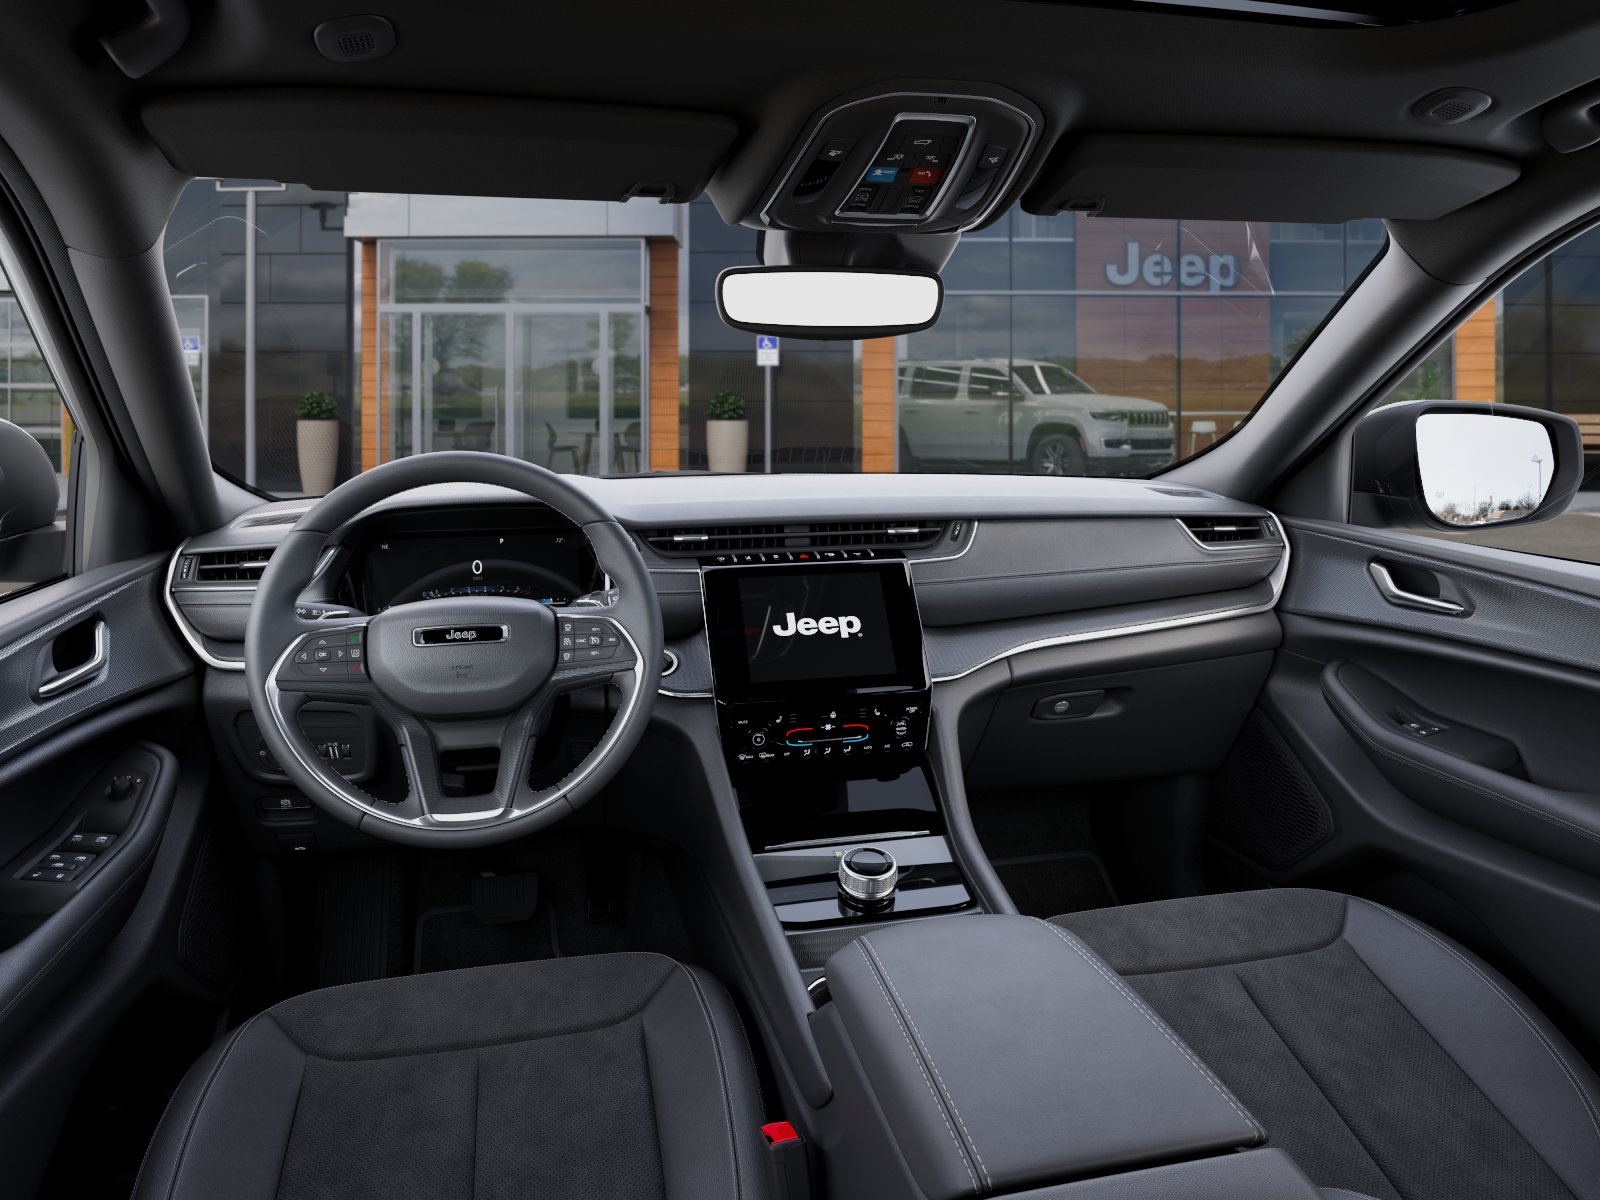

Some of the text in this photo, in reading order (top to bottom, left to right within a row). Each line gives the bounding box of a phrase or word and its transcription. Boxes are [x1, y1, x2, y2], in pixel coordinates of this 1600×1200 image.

[1105, 241, 1240, 292] Jeep
[471, 559, 483, 575] 0
[446, 630, 477, 641] Jeep
[773, 612, 861, 638] Jeep
